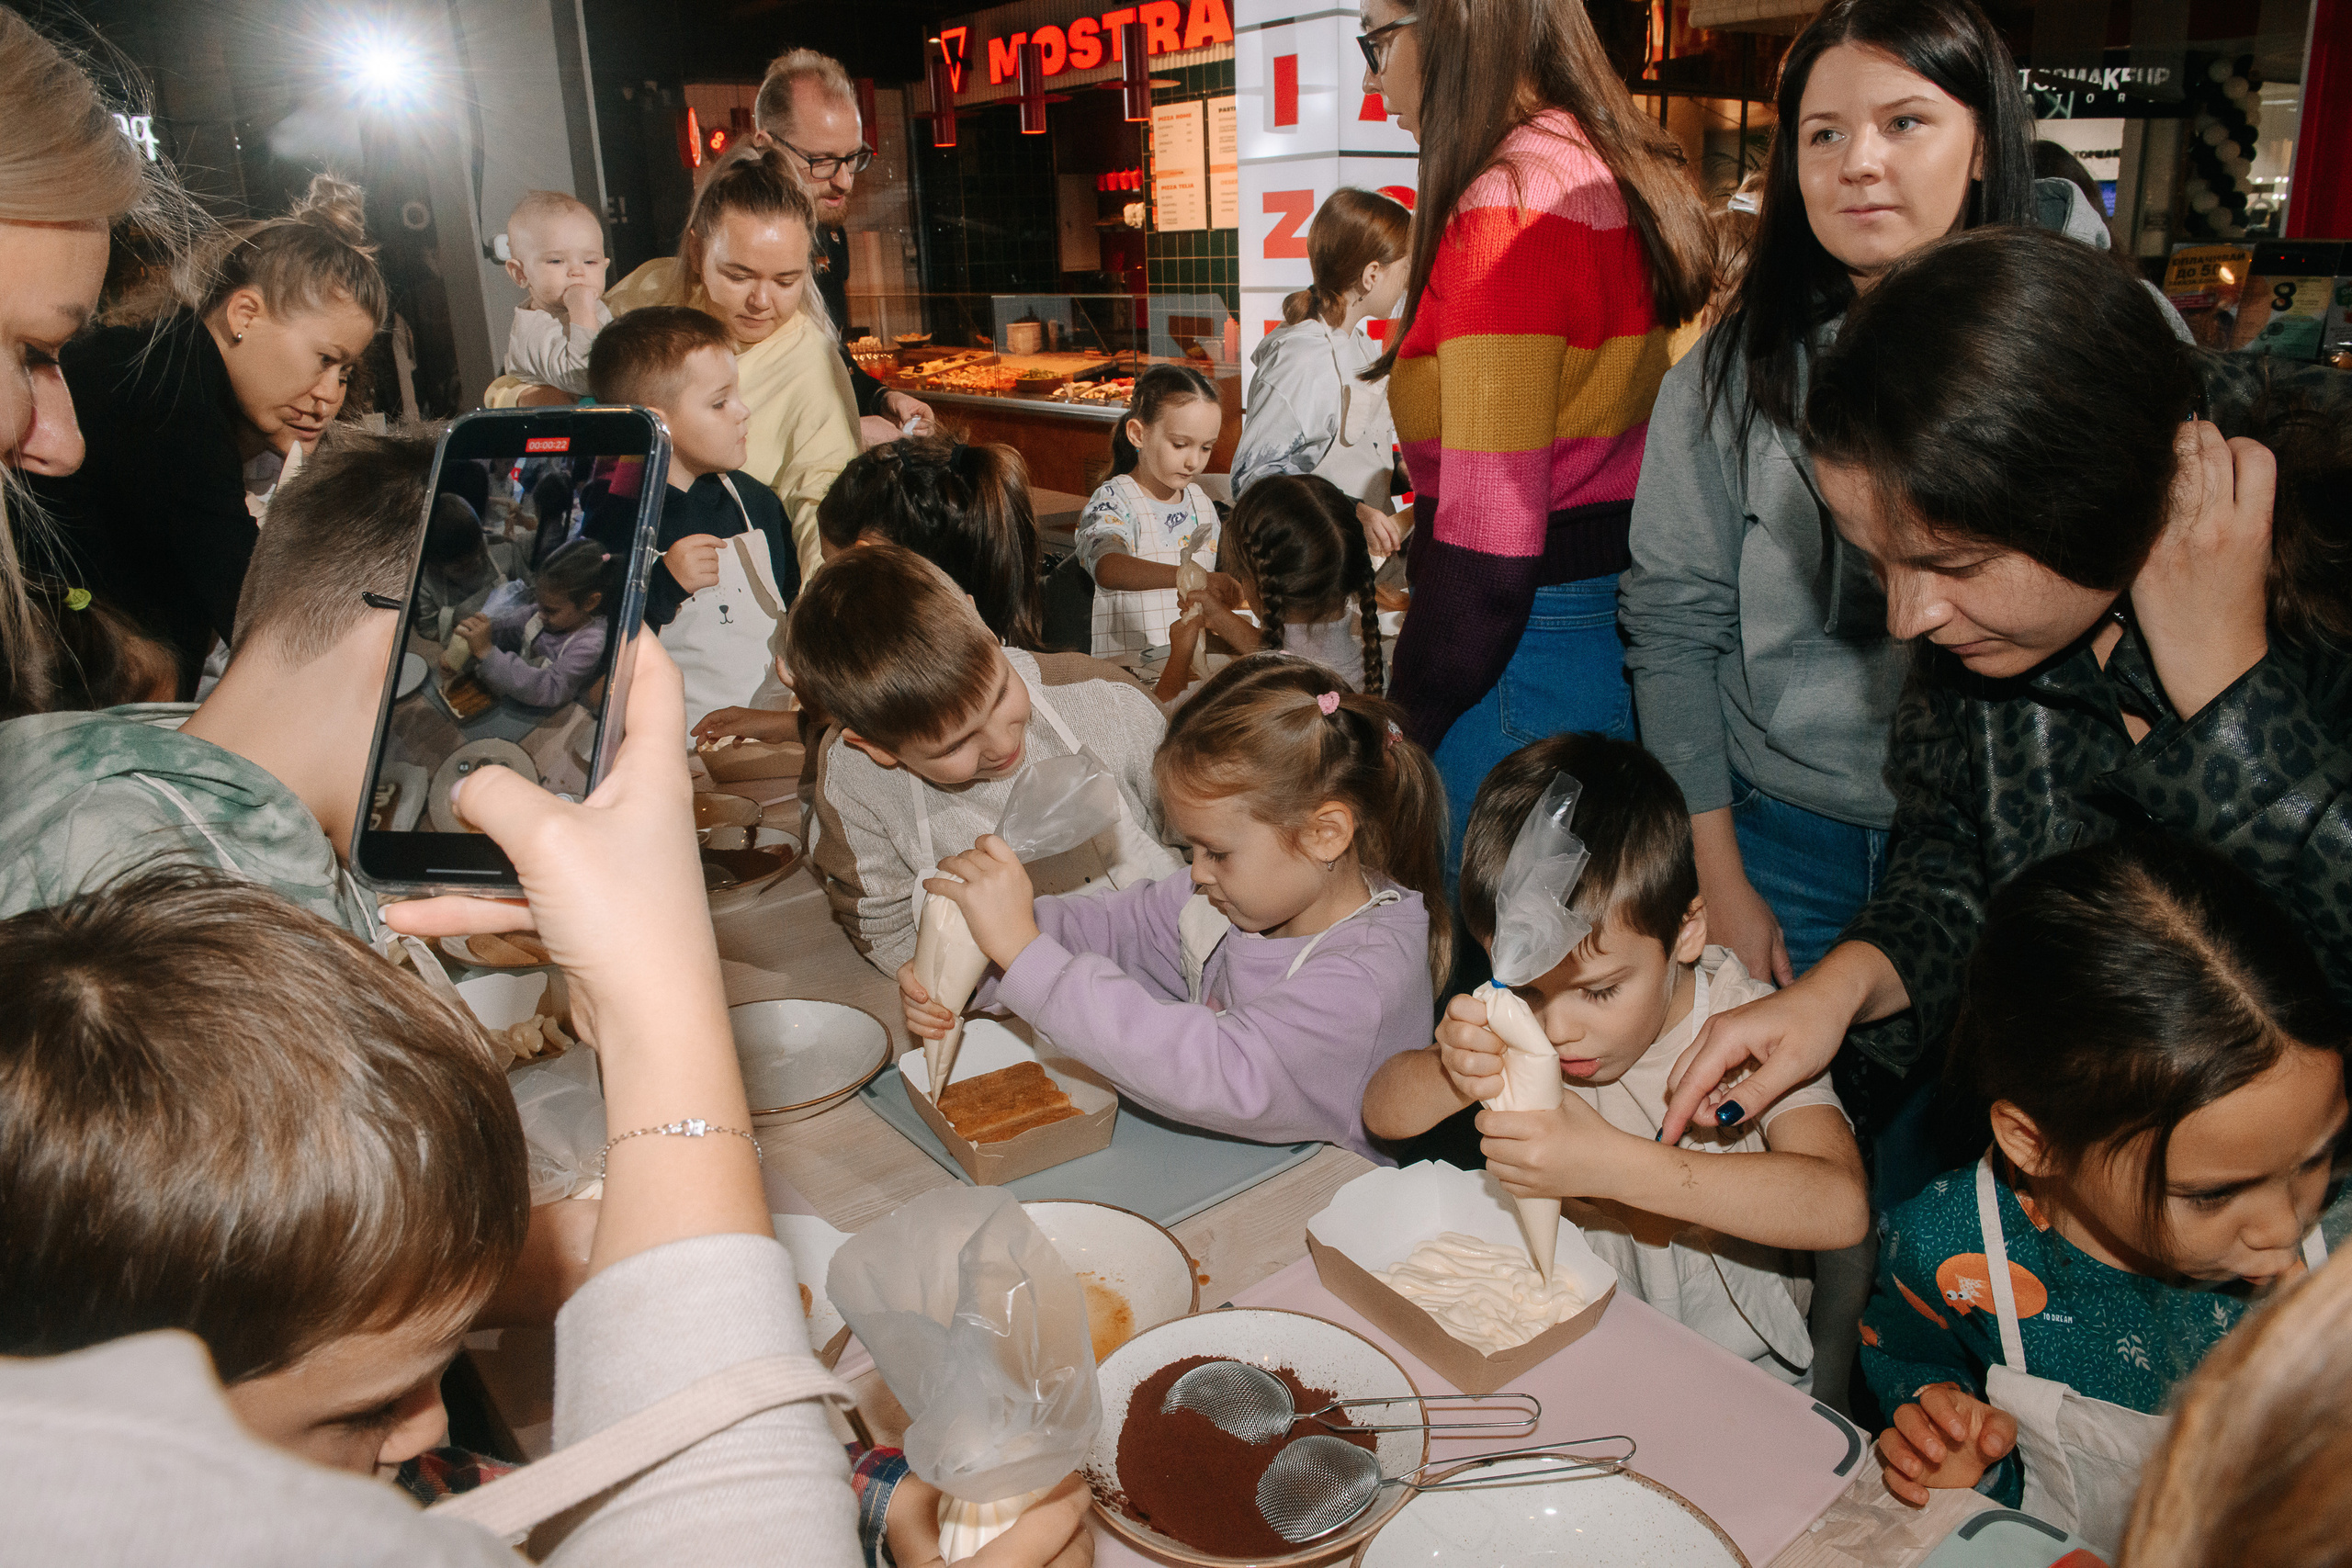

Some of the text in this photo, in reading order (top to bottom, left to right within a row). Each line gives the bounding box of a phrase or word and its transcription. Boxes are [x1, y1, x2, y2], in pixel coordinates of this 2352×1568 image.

[988, 0, 1234, 85] MOSTRA
[528, 441, 568, 450] 00:00:22
[2051, 1314, 2074, 1324] DREAM
